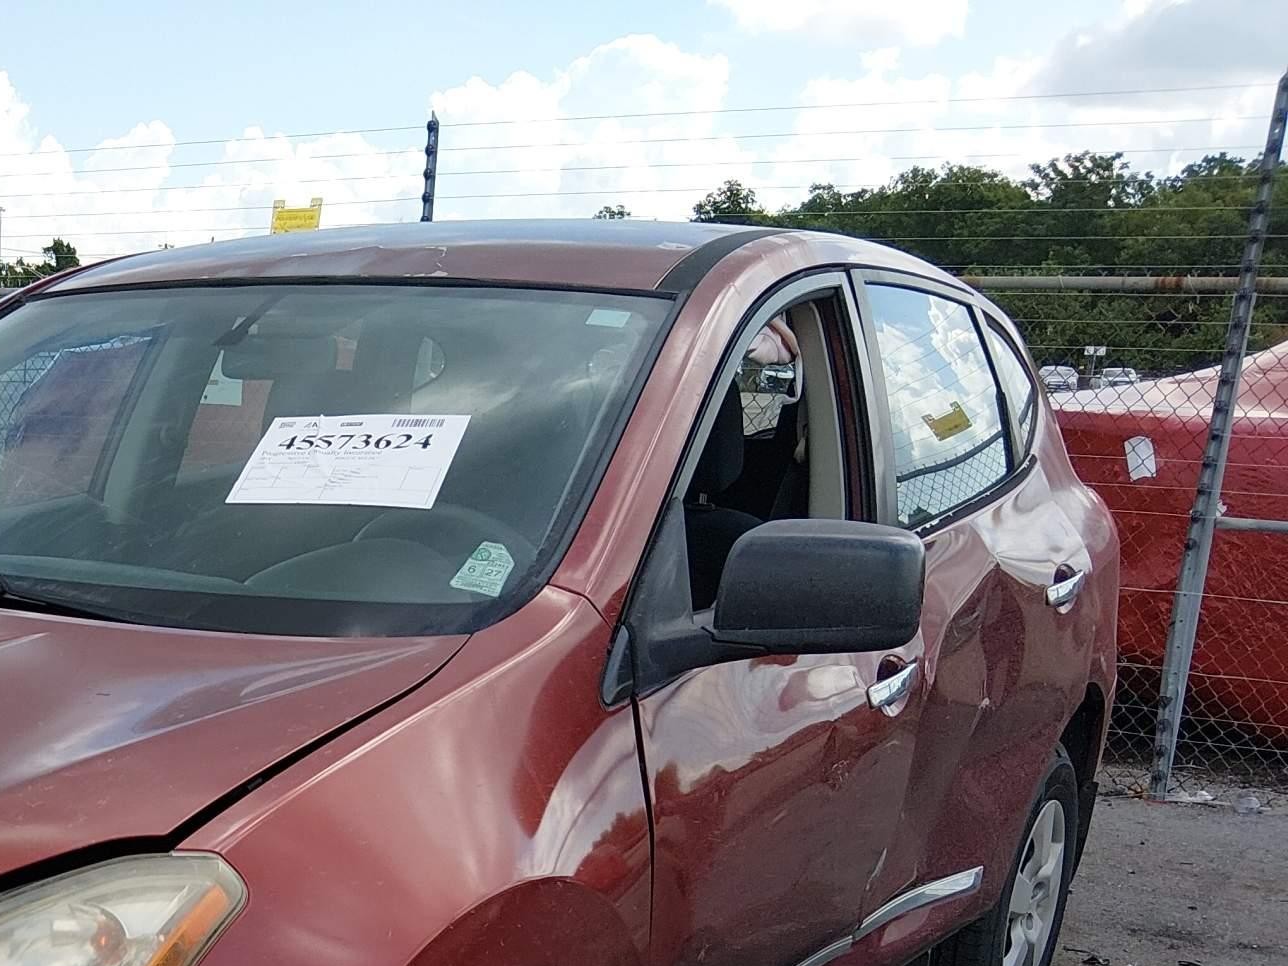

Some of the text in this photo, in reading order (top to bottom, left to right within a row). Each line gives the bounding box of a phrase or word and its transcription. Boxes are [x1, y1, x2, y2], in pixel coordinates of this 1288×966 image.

[278, 433, 434, 450] 45573624
[467, 565, 502, 577] 6 27
